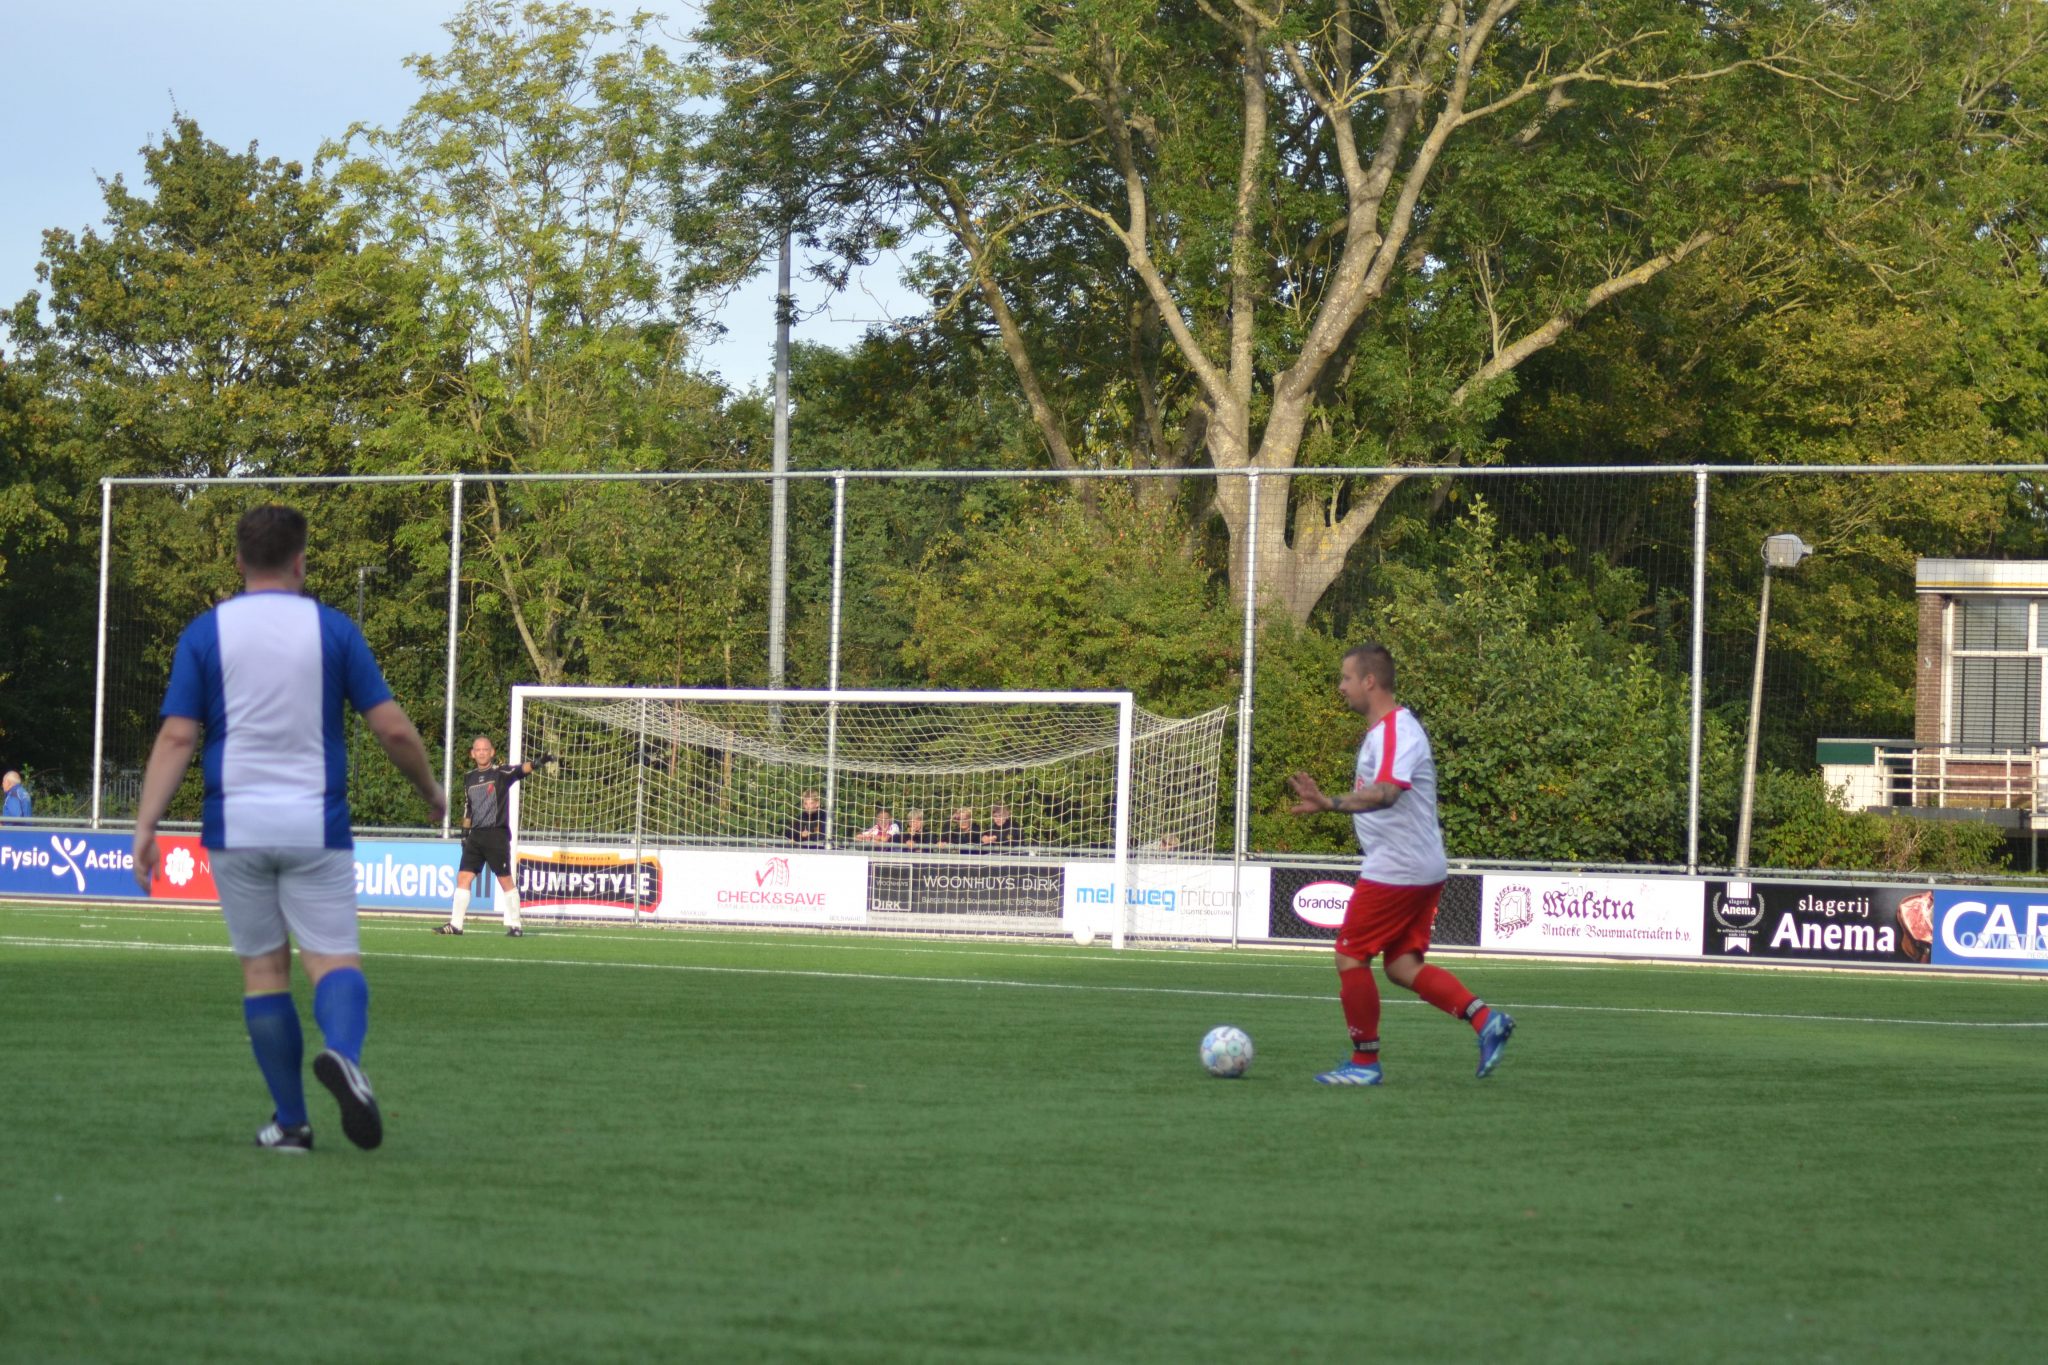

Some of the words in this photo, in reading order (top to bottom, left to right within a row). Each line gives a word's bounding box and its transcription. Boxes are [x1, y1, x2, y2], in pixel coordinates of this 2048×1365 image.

[0, 846, 50, 871] Fysio
[520, 869, 650, 896] JUMPSTYLE
[922, 875, 1016, 890] WOONHUYS
[1022, 878, 1059, 891] DIRK
[716, 890, 826, 906] CHECK&SAVE
[872, 898, 900, 910] DIRK
[1076, 882, 1176, 912] melweg
[1180, 884, 1242, 907] fritom
[1728, 898, 1750, 906] slagerij
[1799, 894, 1869, 917] slagerij
[1721, 903, 1757, 916] Anema
[1544, 923, 1581, 937] Antieke
[1586, 924, 1672, 940] Bouwmaterialen
[1771, 913, 1896, 952] Anema
